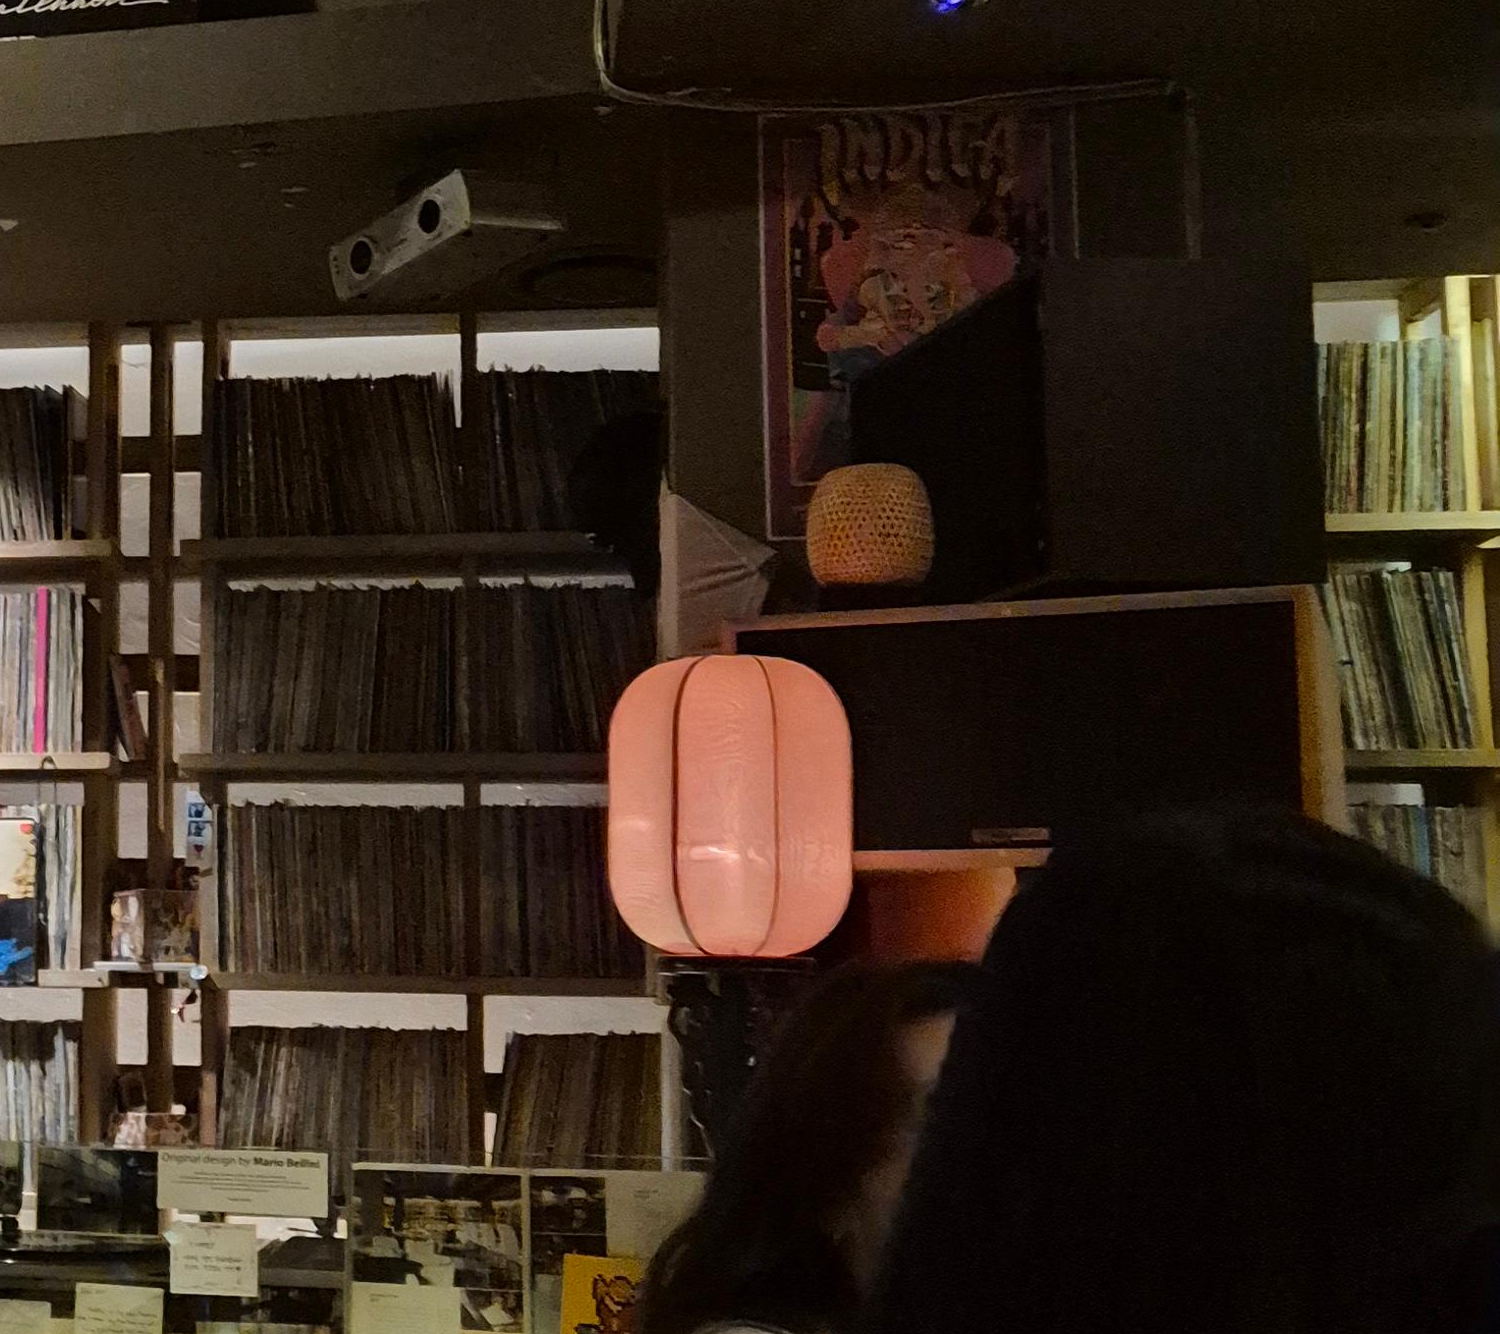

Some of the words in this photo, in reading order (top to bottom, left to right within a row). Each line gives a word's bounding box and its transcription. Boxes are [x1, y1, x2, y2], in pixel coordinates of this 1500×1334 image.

[161, 1152, 201, 1165] Original
[203, 1155, 236, 1167] design
[238, 1156, 252, 1166] by
[253, 1156, 285, 1167] Mario
